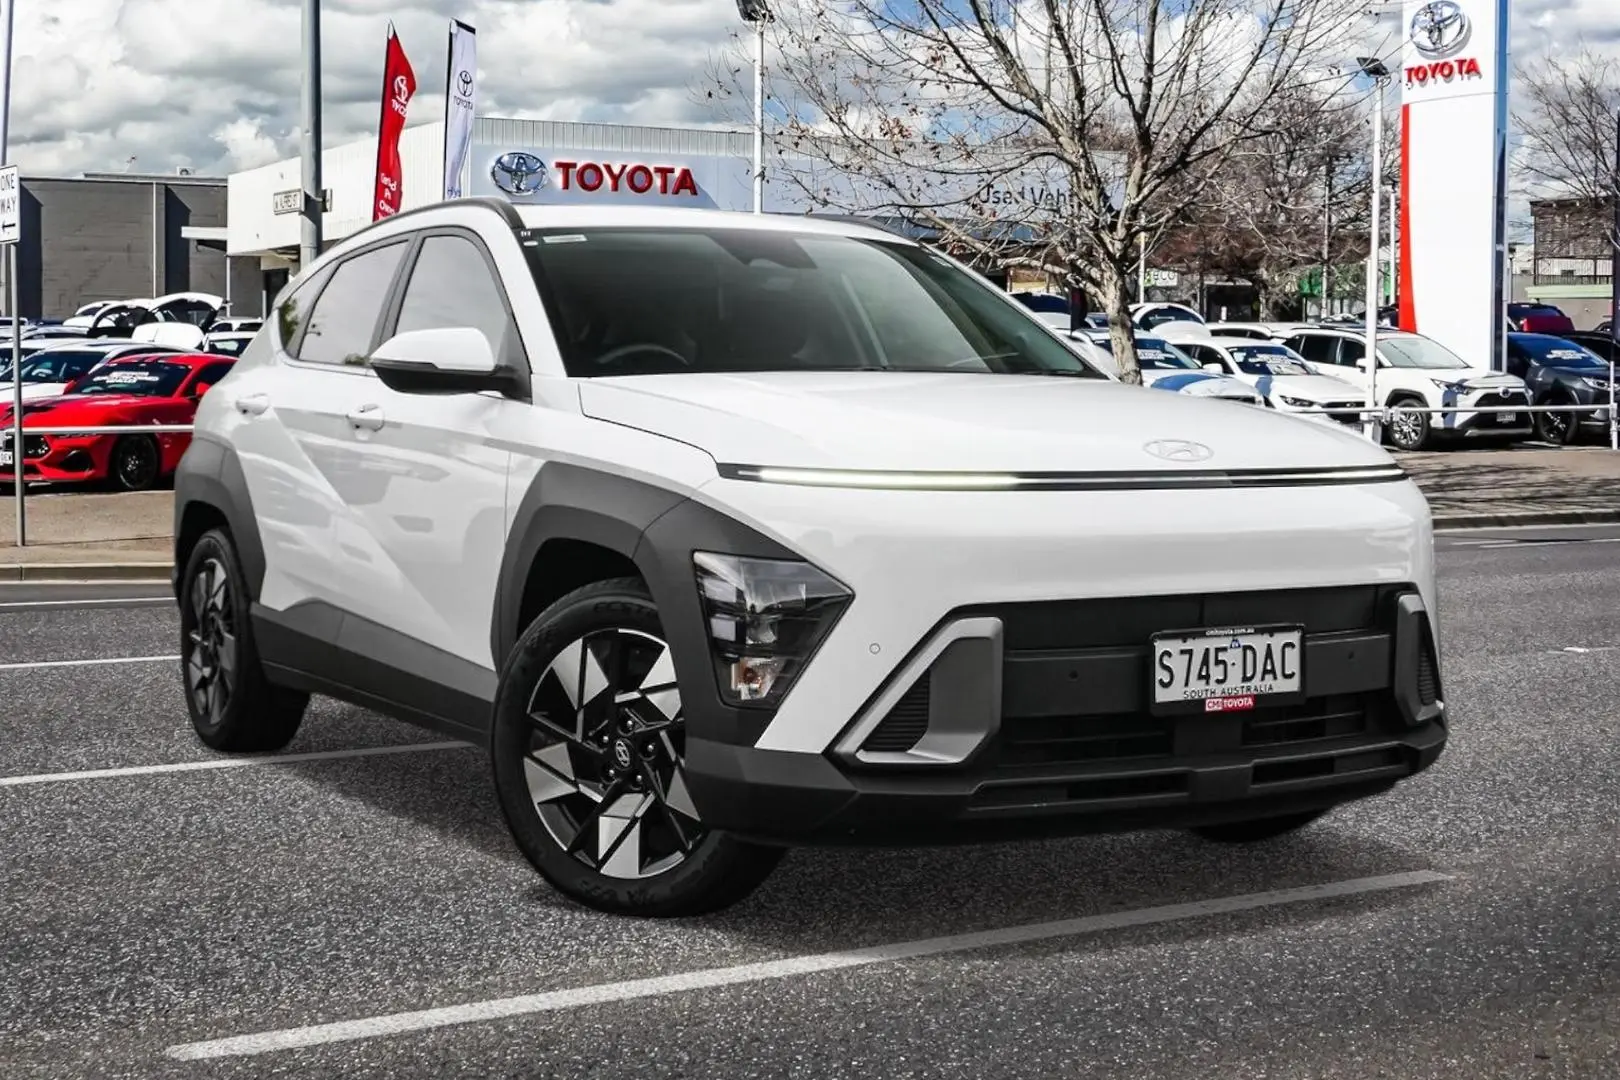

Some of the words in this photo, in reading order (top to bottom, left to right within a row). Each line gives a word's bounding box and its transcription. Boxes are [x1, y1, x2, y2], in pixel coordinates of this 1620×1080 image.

[1404, 58, 1481, 83] TOYOTA
[1, 173, 15, 191] ONE
[555, 161, 698, 196] TOYOTA
[0, 196, 16, 214] WAY
[1183, 689, 1216, 699] SOUTH
[1221, 683, 1273, 696] AUSTRALIA
[1223, 698, 1253, 708] TOYOTA
